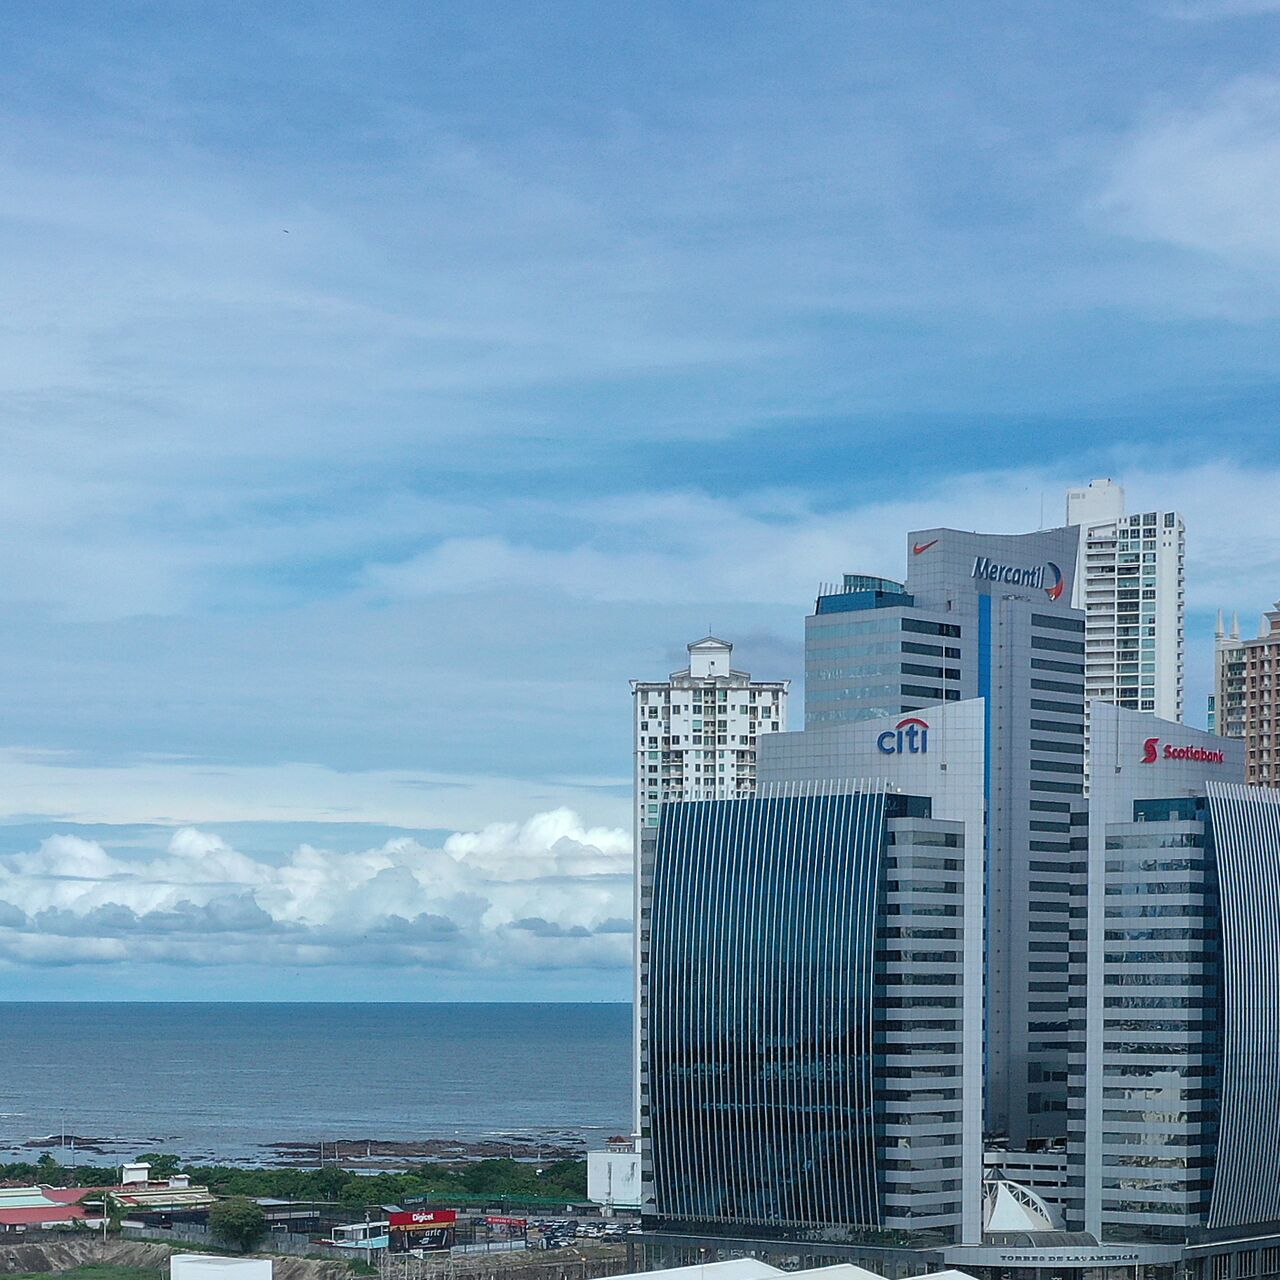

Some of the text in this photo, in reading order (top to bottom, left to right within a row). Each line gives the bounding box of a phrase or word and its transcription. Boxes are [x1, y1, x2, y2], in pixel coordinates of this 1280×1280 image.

[971, 556, 1045, 589] Mercantil
[877, 724, 928, 754] citi
[1163, 744, 1224, 764] Scotiabank
[412, 1213, 434, 1222] Digicel
